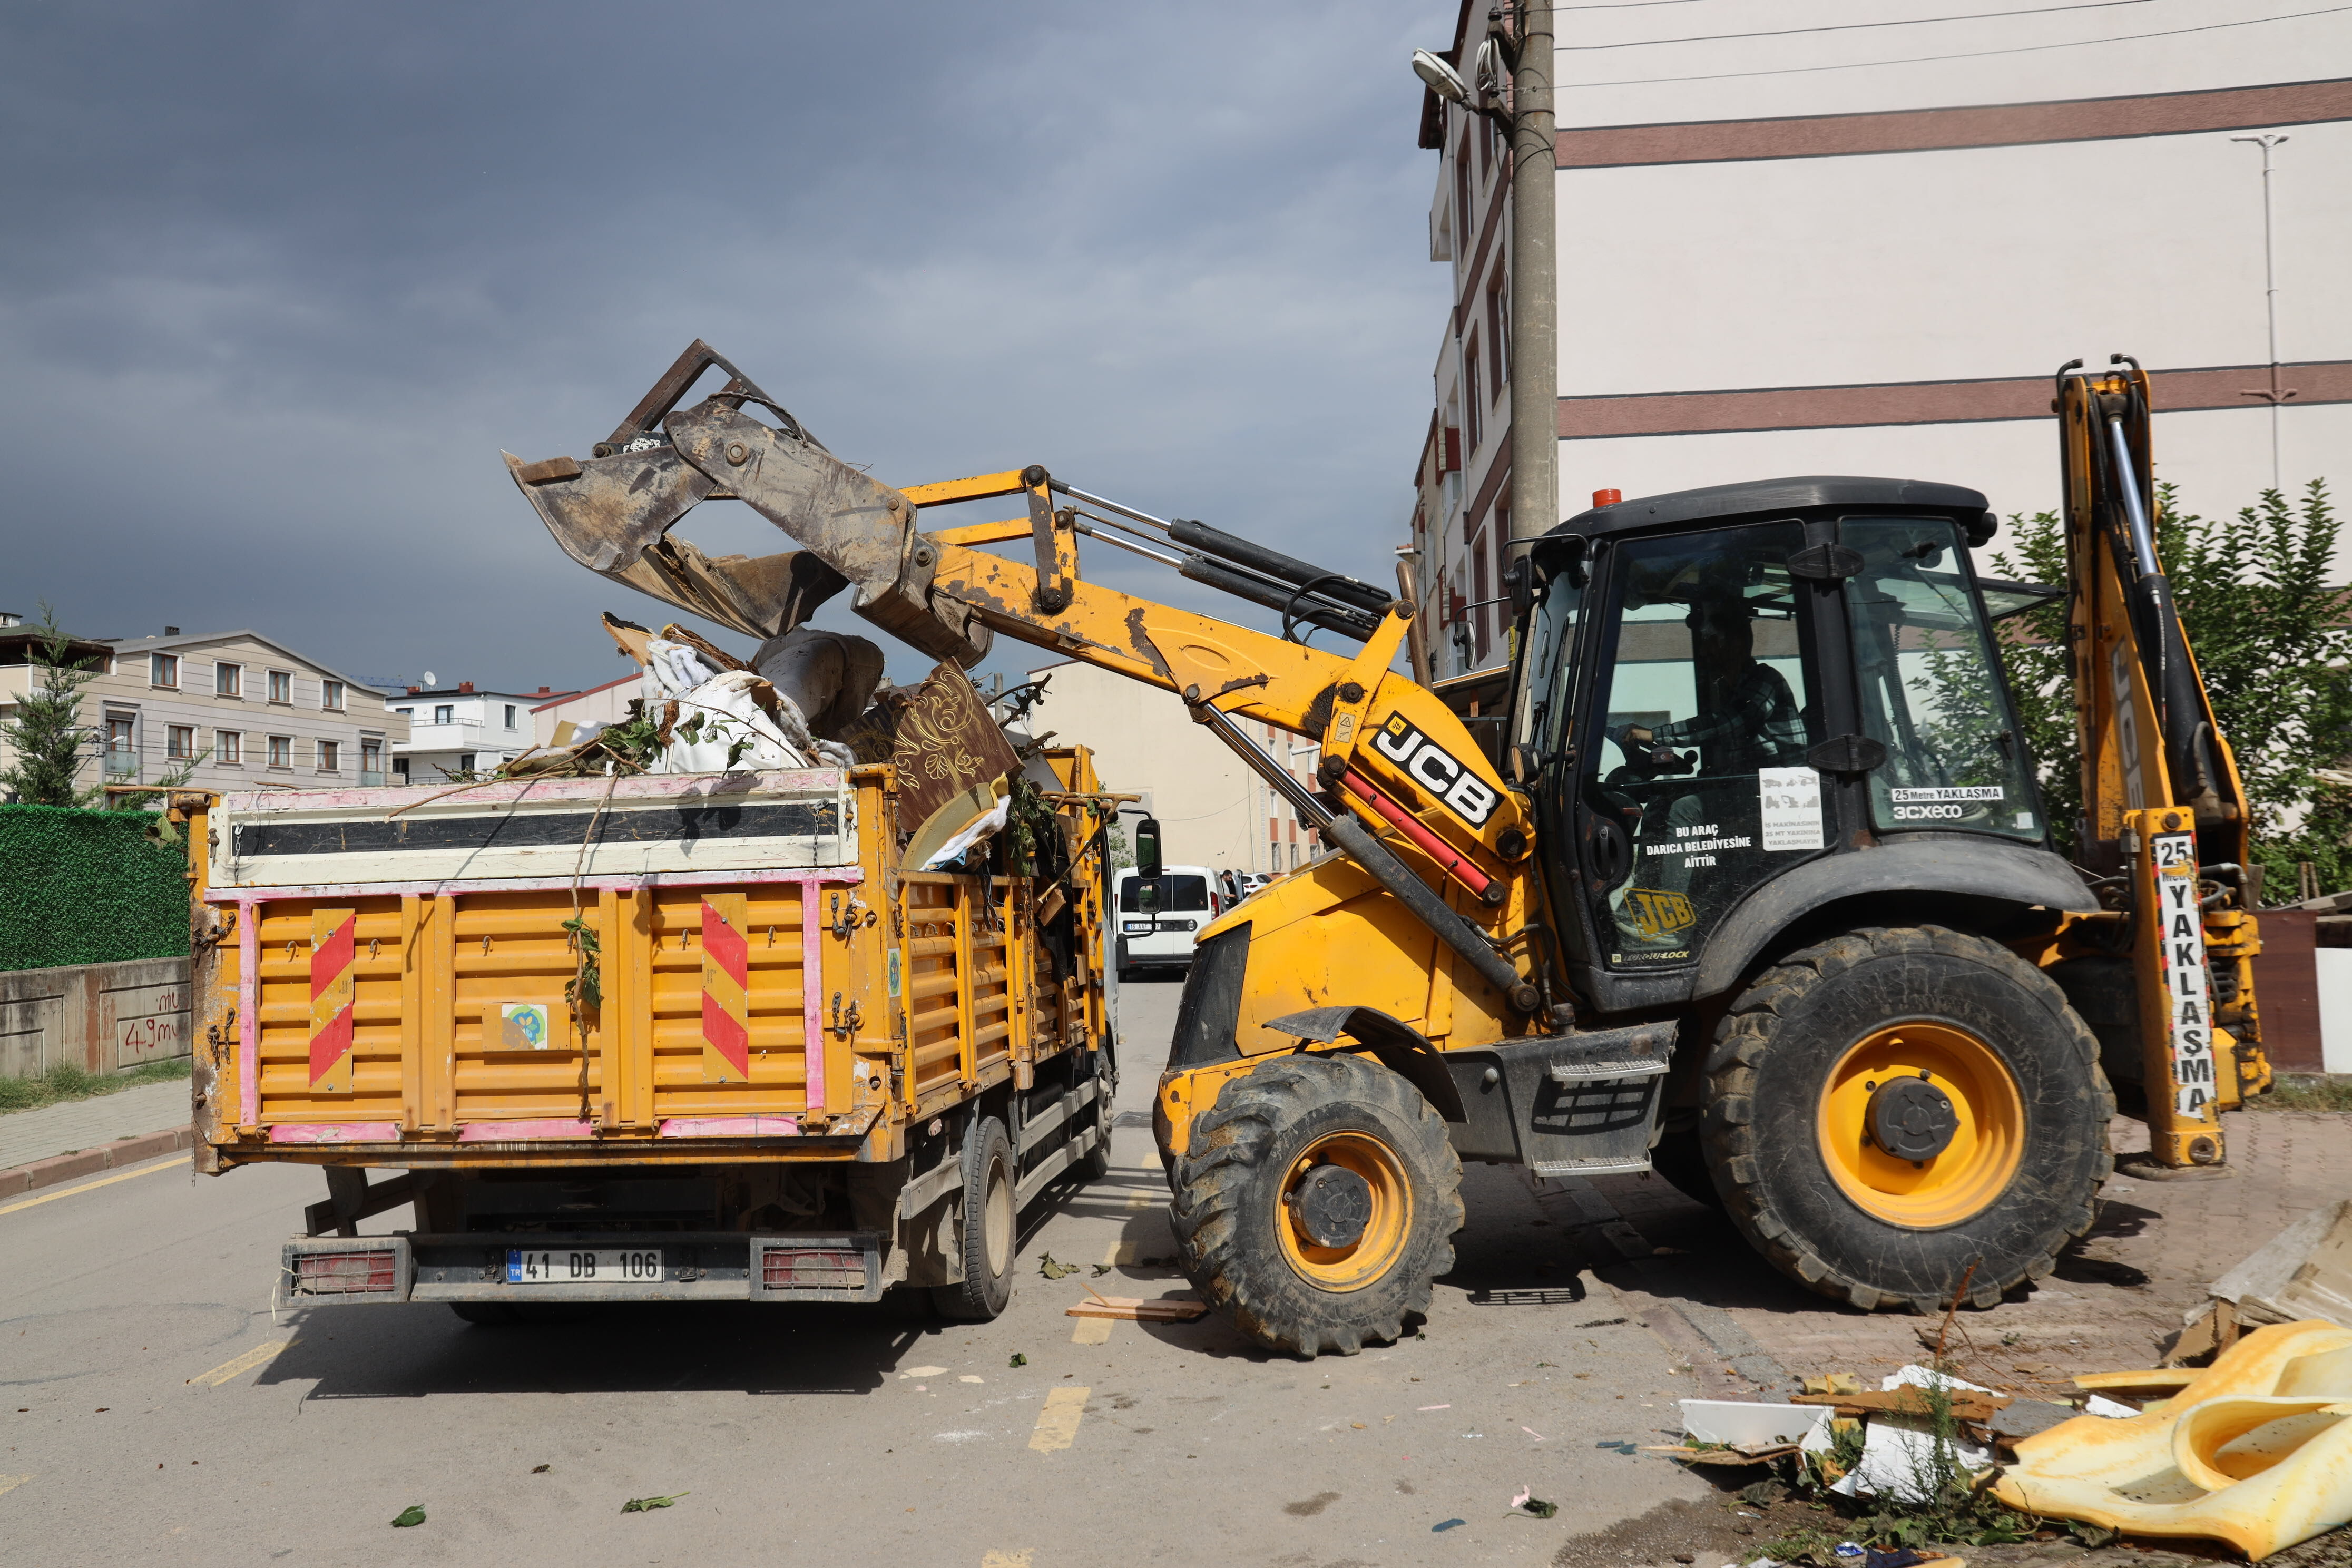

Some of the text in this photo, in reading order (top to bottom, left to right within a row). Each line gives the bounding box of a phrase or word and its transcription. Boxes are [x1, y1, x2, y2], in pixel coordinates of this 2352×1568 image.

[1393, 721, 1402, 730] JCB
[1377, 731, 1496, 823] JCB
[1895, 790, 1908, 800] 25
[1936, 788, 2000, 799] YAKLAŞMA
[1675, 824, 1719, 837] BU ARAÇ
[1647, 836, 1751, 856] DARICA BELEDİYESİNE
[2161, 841, 2187, 866] 25
[1684, 854, 1717, 868] AİTTİR
[1635, 894, 1690, 935] JCB
[2169, 885, 2210, 1112] YAKLAŞMA
[526, 1252, 656, 1279] 41 DB 106
